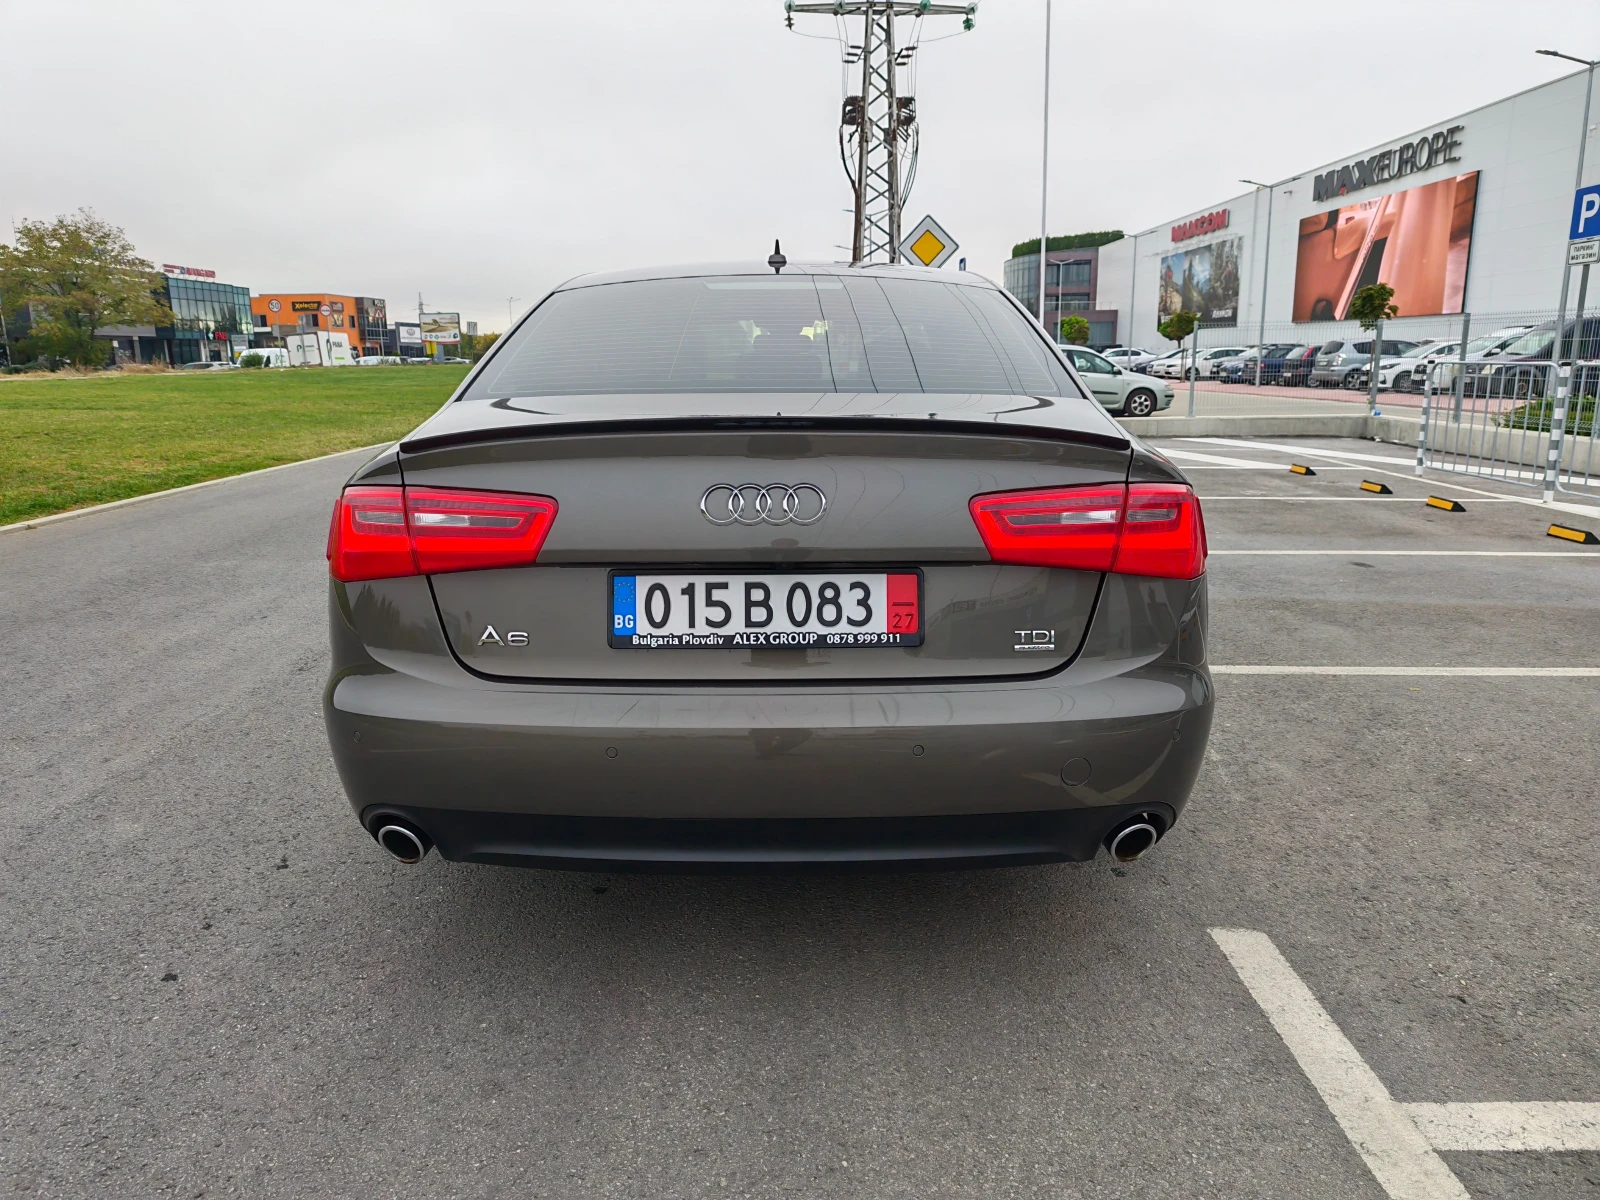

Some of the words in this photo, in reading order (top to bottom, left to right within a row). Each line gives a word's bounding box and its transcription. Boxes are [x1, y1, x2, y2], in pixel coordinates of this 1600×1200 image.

[1578, 193, 1600, 233] P
[270, 302, 279, 310] 50
[614, 614, 634, 629] BG
[892, 612, 914, 629] 27
[477, 625, 529, 646] A6
[632, 634, 679, 647] Bulgaria
[682, 634, 724, 645] Plovdiv
[733, 633, 766, 645] ALEX
[769, 633, 818, 645] GROUP
[826, 634, 855, 644] 0878
[857, 634, 878, 643] 999
[881, 633, 900, 643] 911
[1014, 629, 1055, 643] TDI
